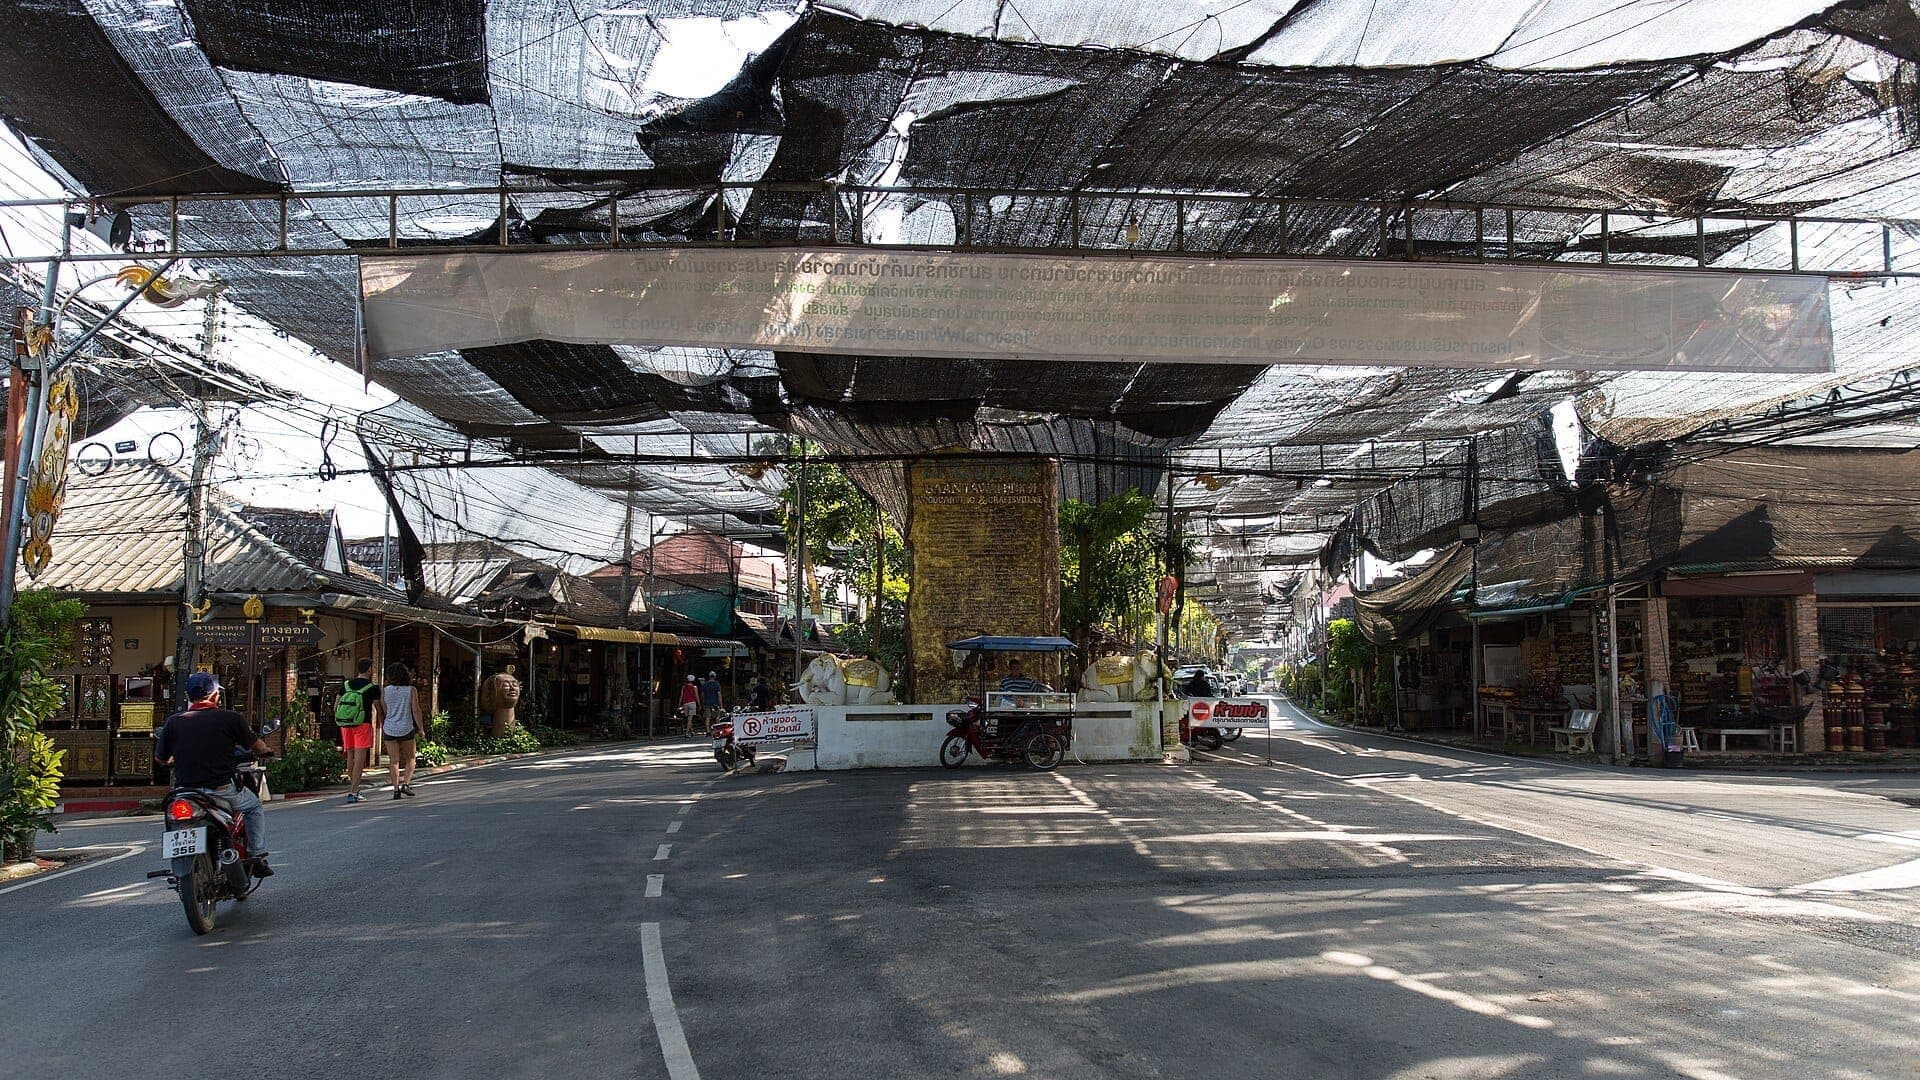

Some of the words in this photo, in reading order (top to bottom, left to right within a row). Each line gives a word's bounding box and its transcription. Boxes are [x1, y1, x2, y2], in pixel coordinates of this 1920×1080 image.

[260, 625, 310, 635] ทางออก
[261, 635, 294, 643] EXIT
[1212, 701, 1268, 718] ห้ามเข้า
[762, 715, 798, 725] ห้ามจอด
[768, 719, 803, 734] บริเวณนี้
